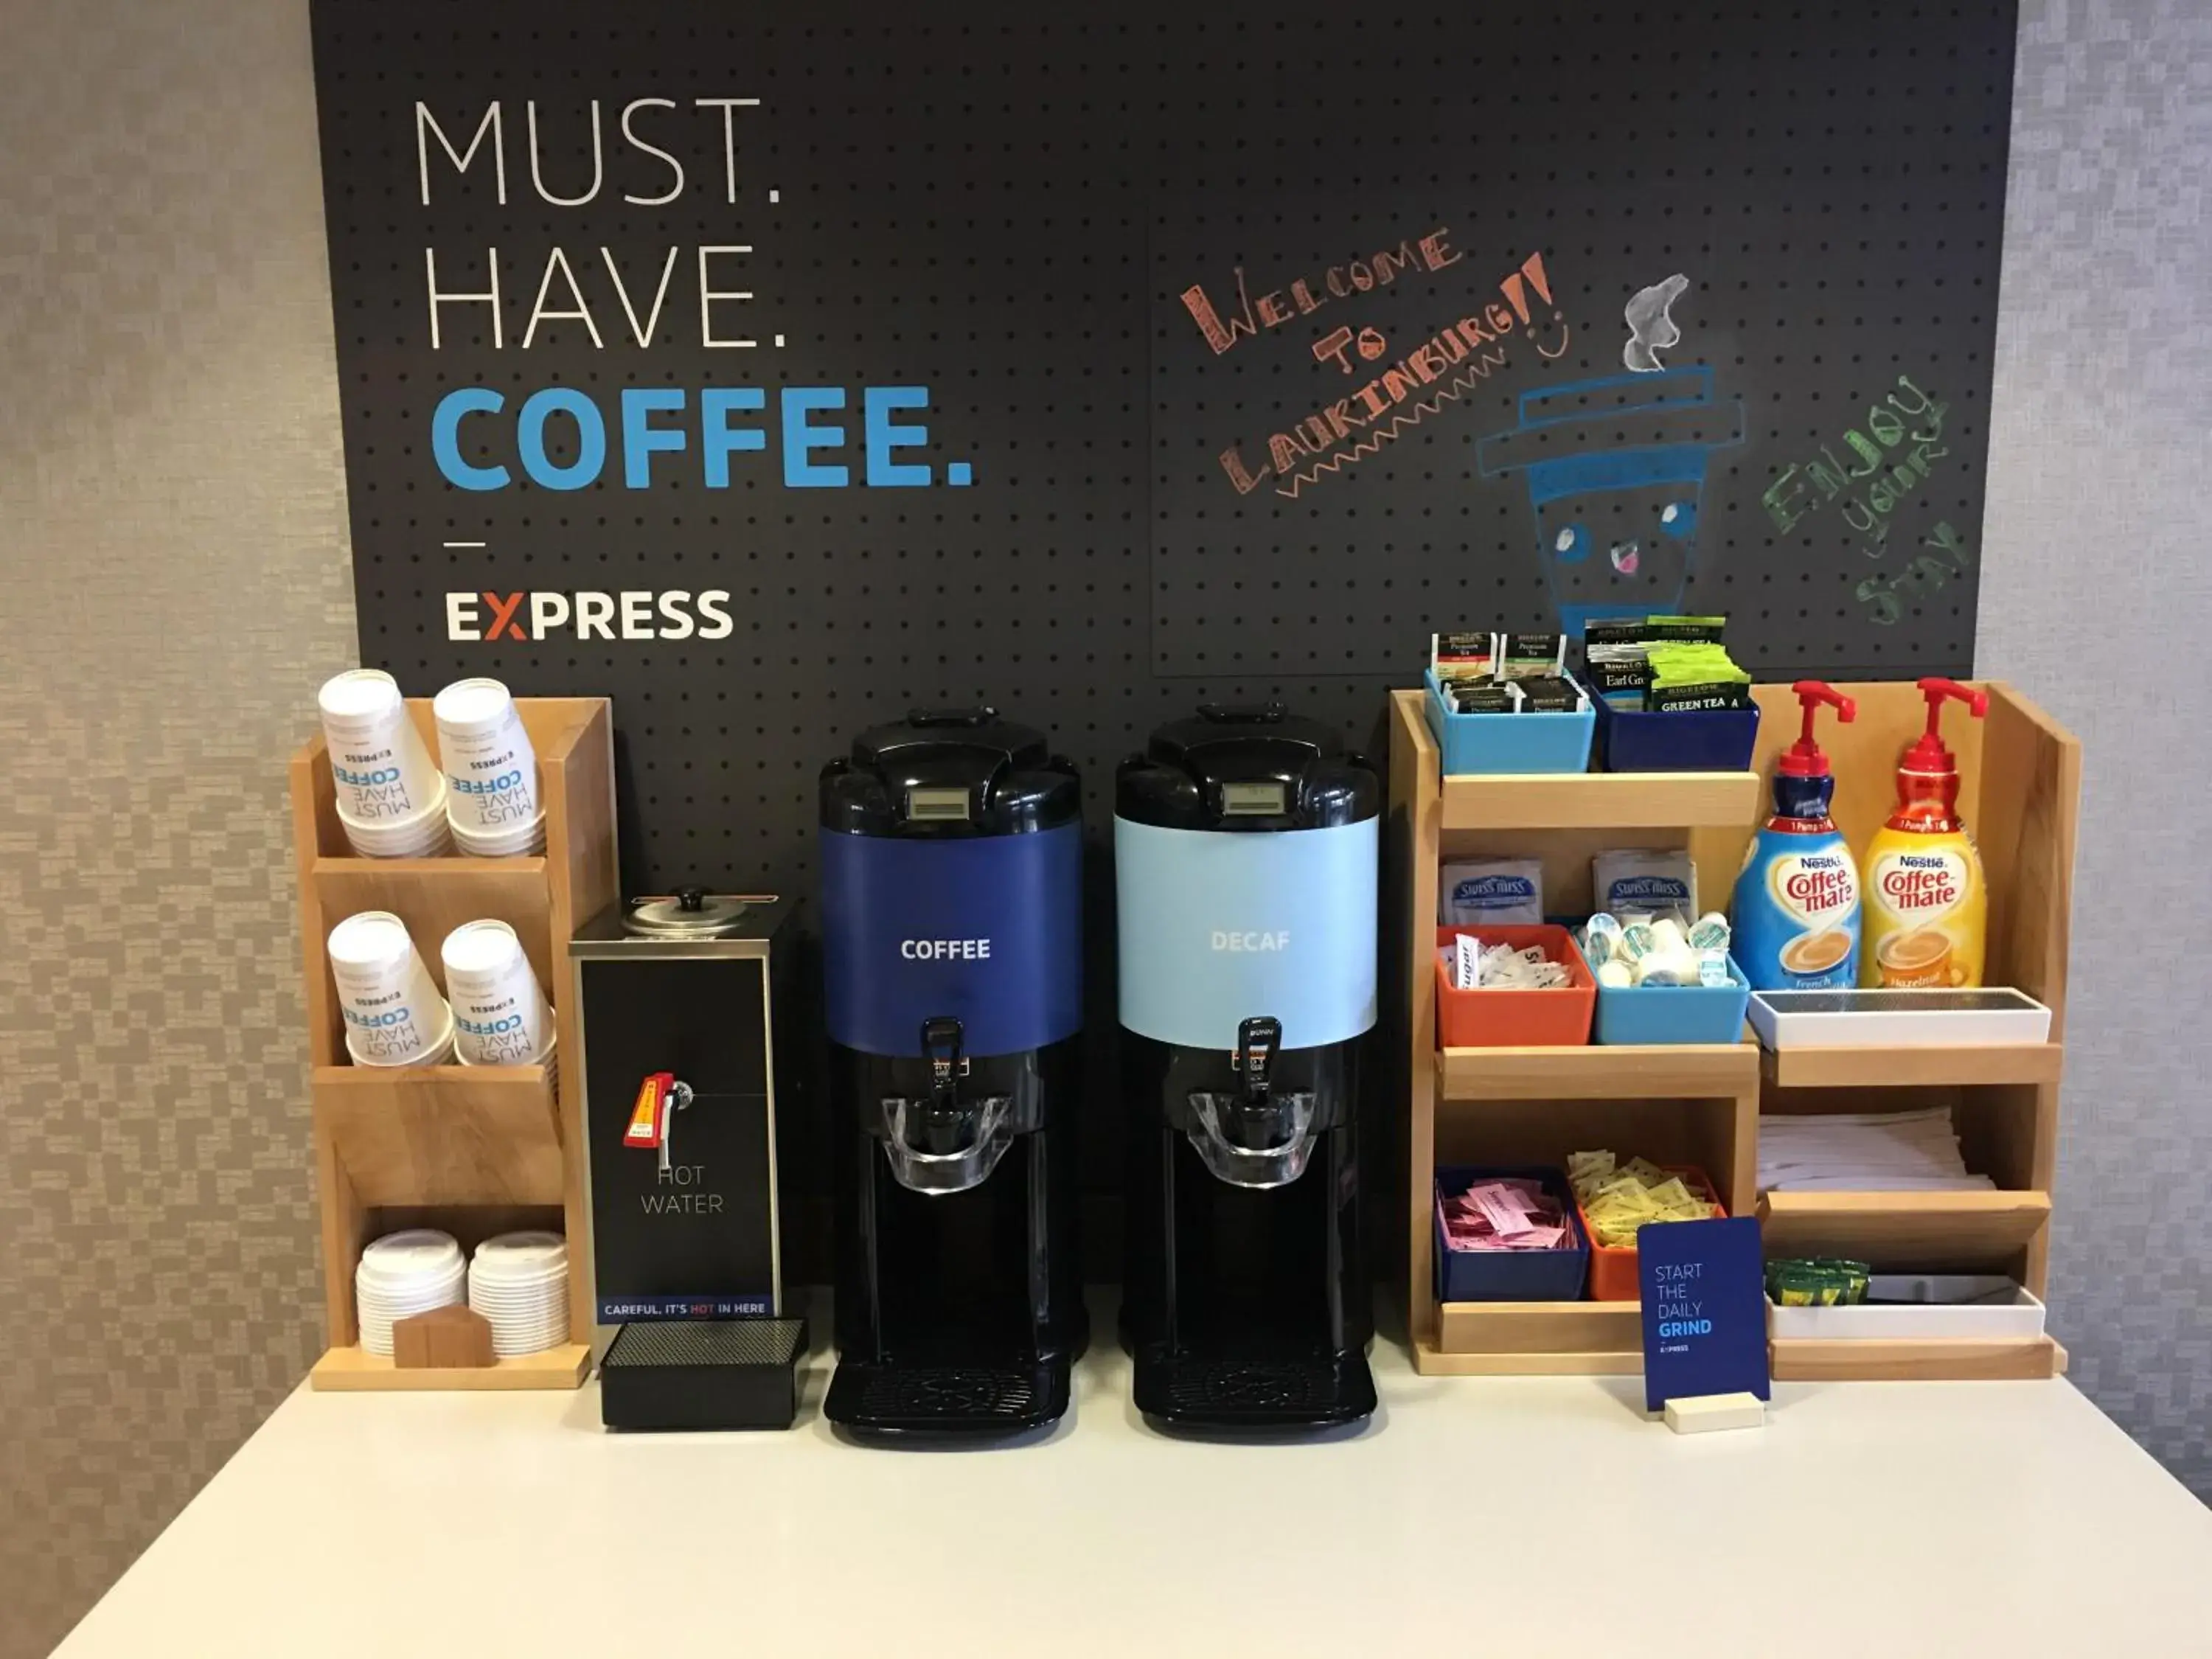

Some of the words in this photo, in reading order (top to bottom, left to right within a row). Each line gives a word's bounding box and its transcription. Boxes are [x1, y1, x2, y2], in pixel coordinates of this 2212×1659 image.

[415, 98, 780, 206] MUST.
[425, 246, 785, 349] HAVE.
[431, 386, 973, 491] COFFEE.
[445, 590, 734, 641] EXPRESS
[1661, 700, 1701, 712] GREEN
[1703, 696, 1725, 709] TEA
[1806, 884, 1852, 912] mate
[1899, 886, 1955, 909] mate
[900, 939, 991, 959] COFFEE
[1211, 931, 1291, 952] DECAF
[658, 1165, 705, 1185] HOT
[641, 1194, 724, 1214] WATER
[1655, 1263, 1703, 1282] START
[1658, 1284, 1687, 1300] THE
[666, 1304, 686, 1314] IT'S
[690, 1304, 714, 1315] HOT
[718, 1304, 731, 1313] IN
[734, 1303, 765, 1313] HERE
[1658, 1300, 1703, 1319] DAILY
[1659, 1320, 1711, 1337] GRIND
